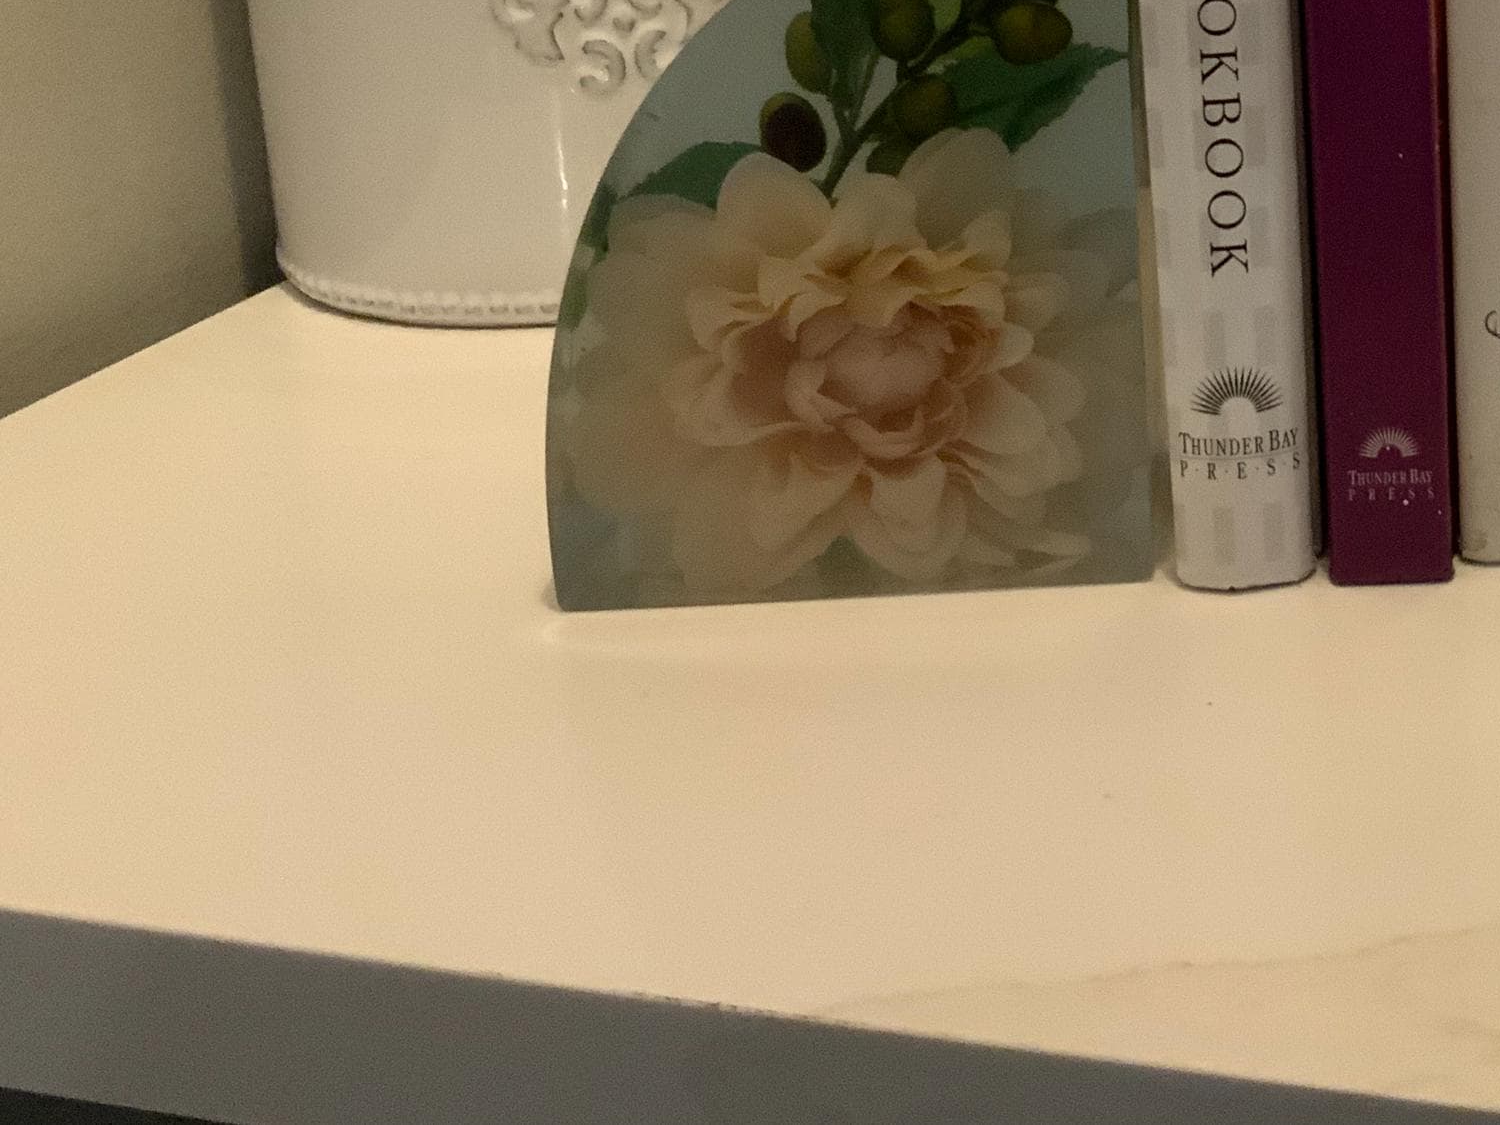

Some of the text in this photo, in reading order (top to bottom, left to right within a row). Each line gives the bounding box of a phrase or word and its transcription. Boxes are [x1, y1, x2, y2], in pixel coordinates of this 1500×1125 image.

[1178, 427, 1299, 457] THUNDER BAY
[1347, 468, 1434, 486] THUNDER BAY
